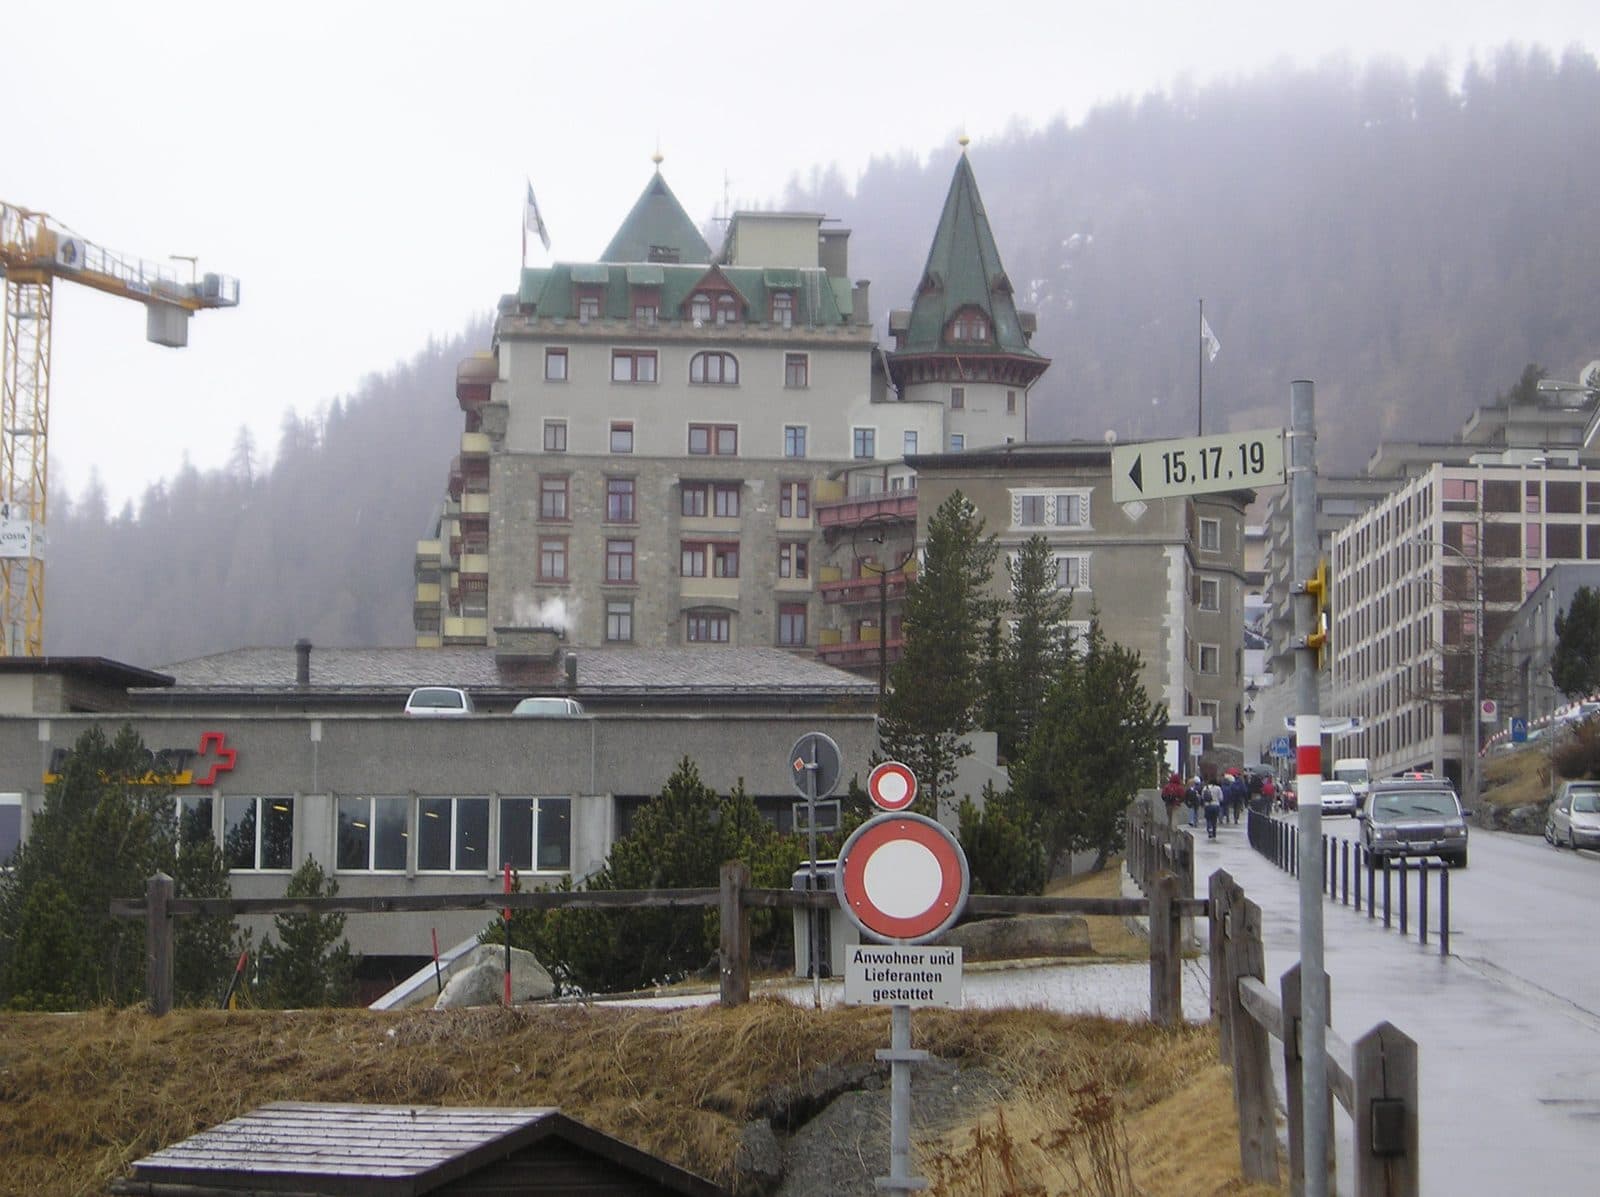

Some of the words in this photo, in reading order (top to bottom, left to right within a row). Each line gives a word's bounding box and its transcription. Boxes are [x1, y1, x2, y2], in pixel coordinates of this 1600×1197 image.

[853, 950, 925, 965] Anwohner
[930, 951, 955, 965] und
[865, 968, 942, 983] Lieferanten
[873, 988, 934, 1002] gestattet
